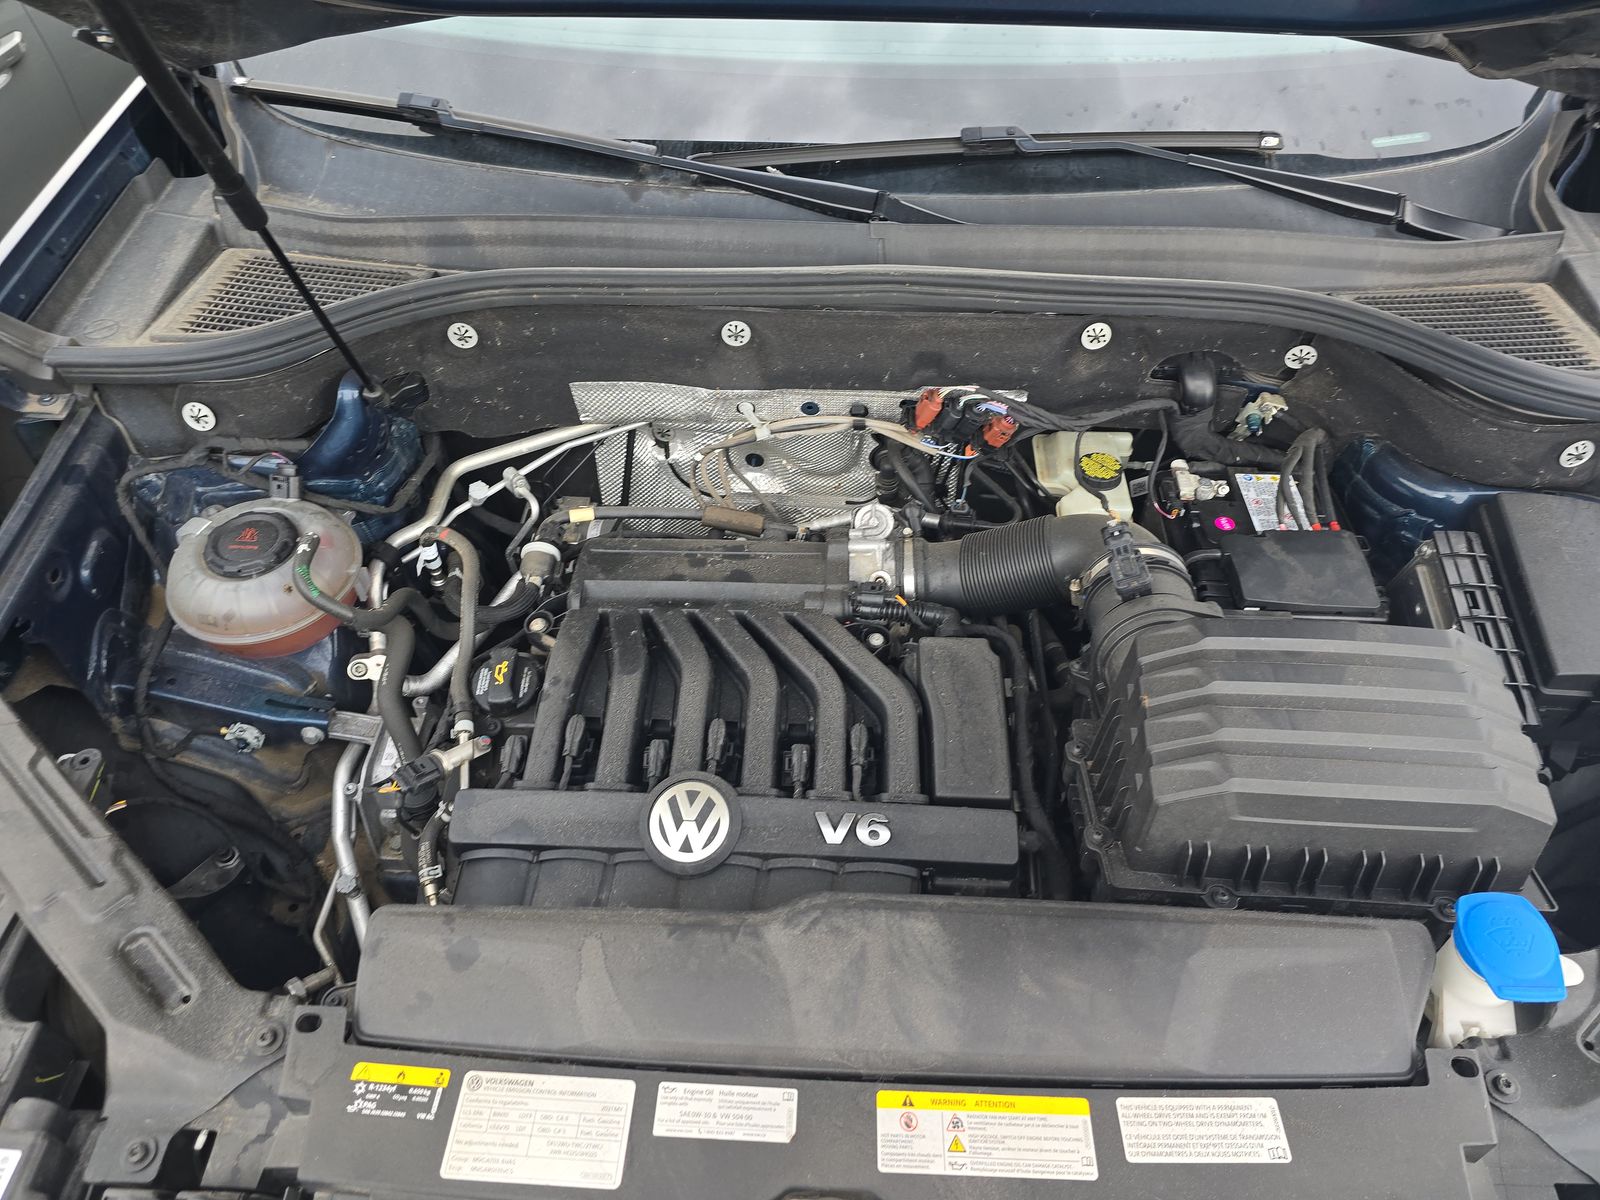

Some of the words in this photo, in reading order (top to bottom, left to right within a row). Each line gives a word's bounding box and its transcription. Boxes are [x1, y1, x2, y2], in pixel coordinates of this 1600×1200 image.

[815, 811, 892, 847] V6
[484, 1077, 534, 1086] VOLKSWAGEN
[683, 1087, 703, 1096] Engine
[930, 1098, 966, 1106] WARNING
[974, 1100, 1016, 1108] ATTENTION
